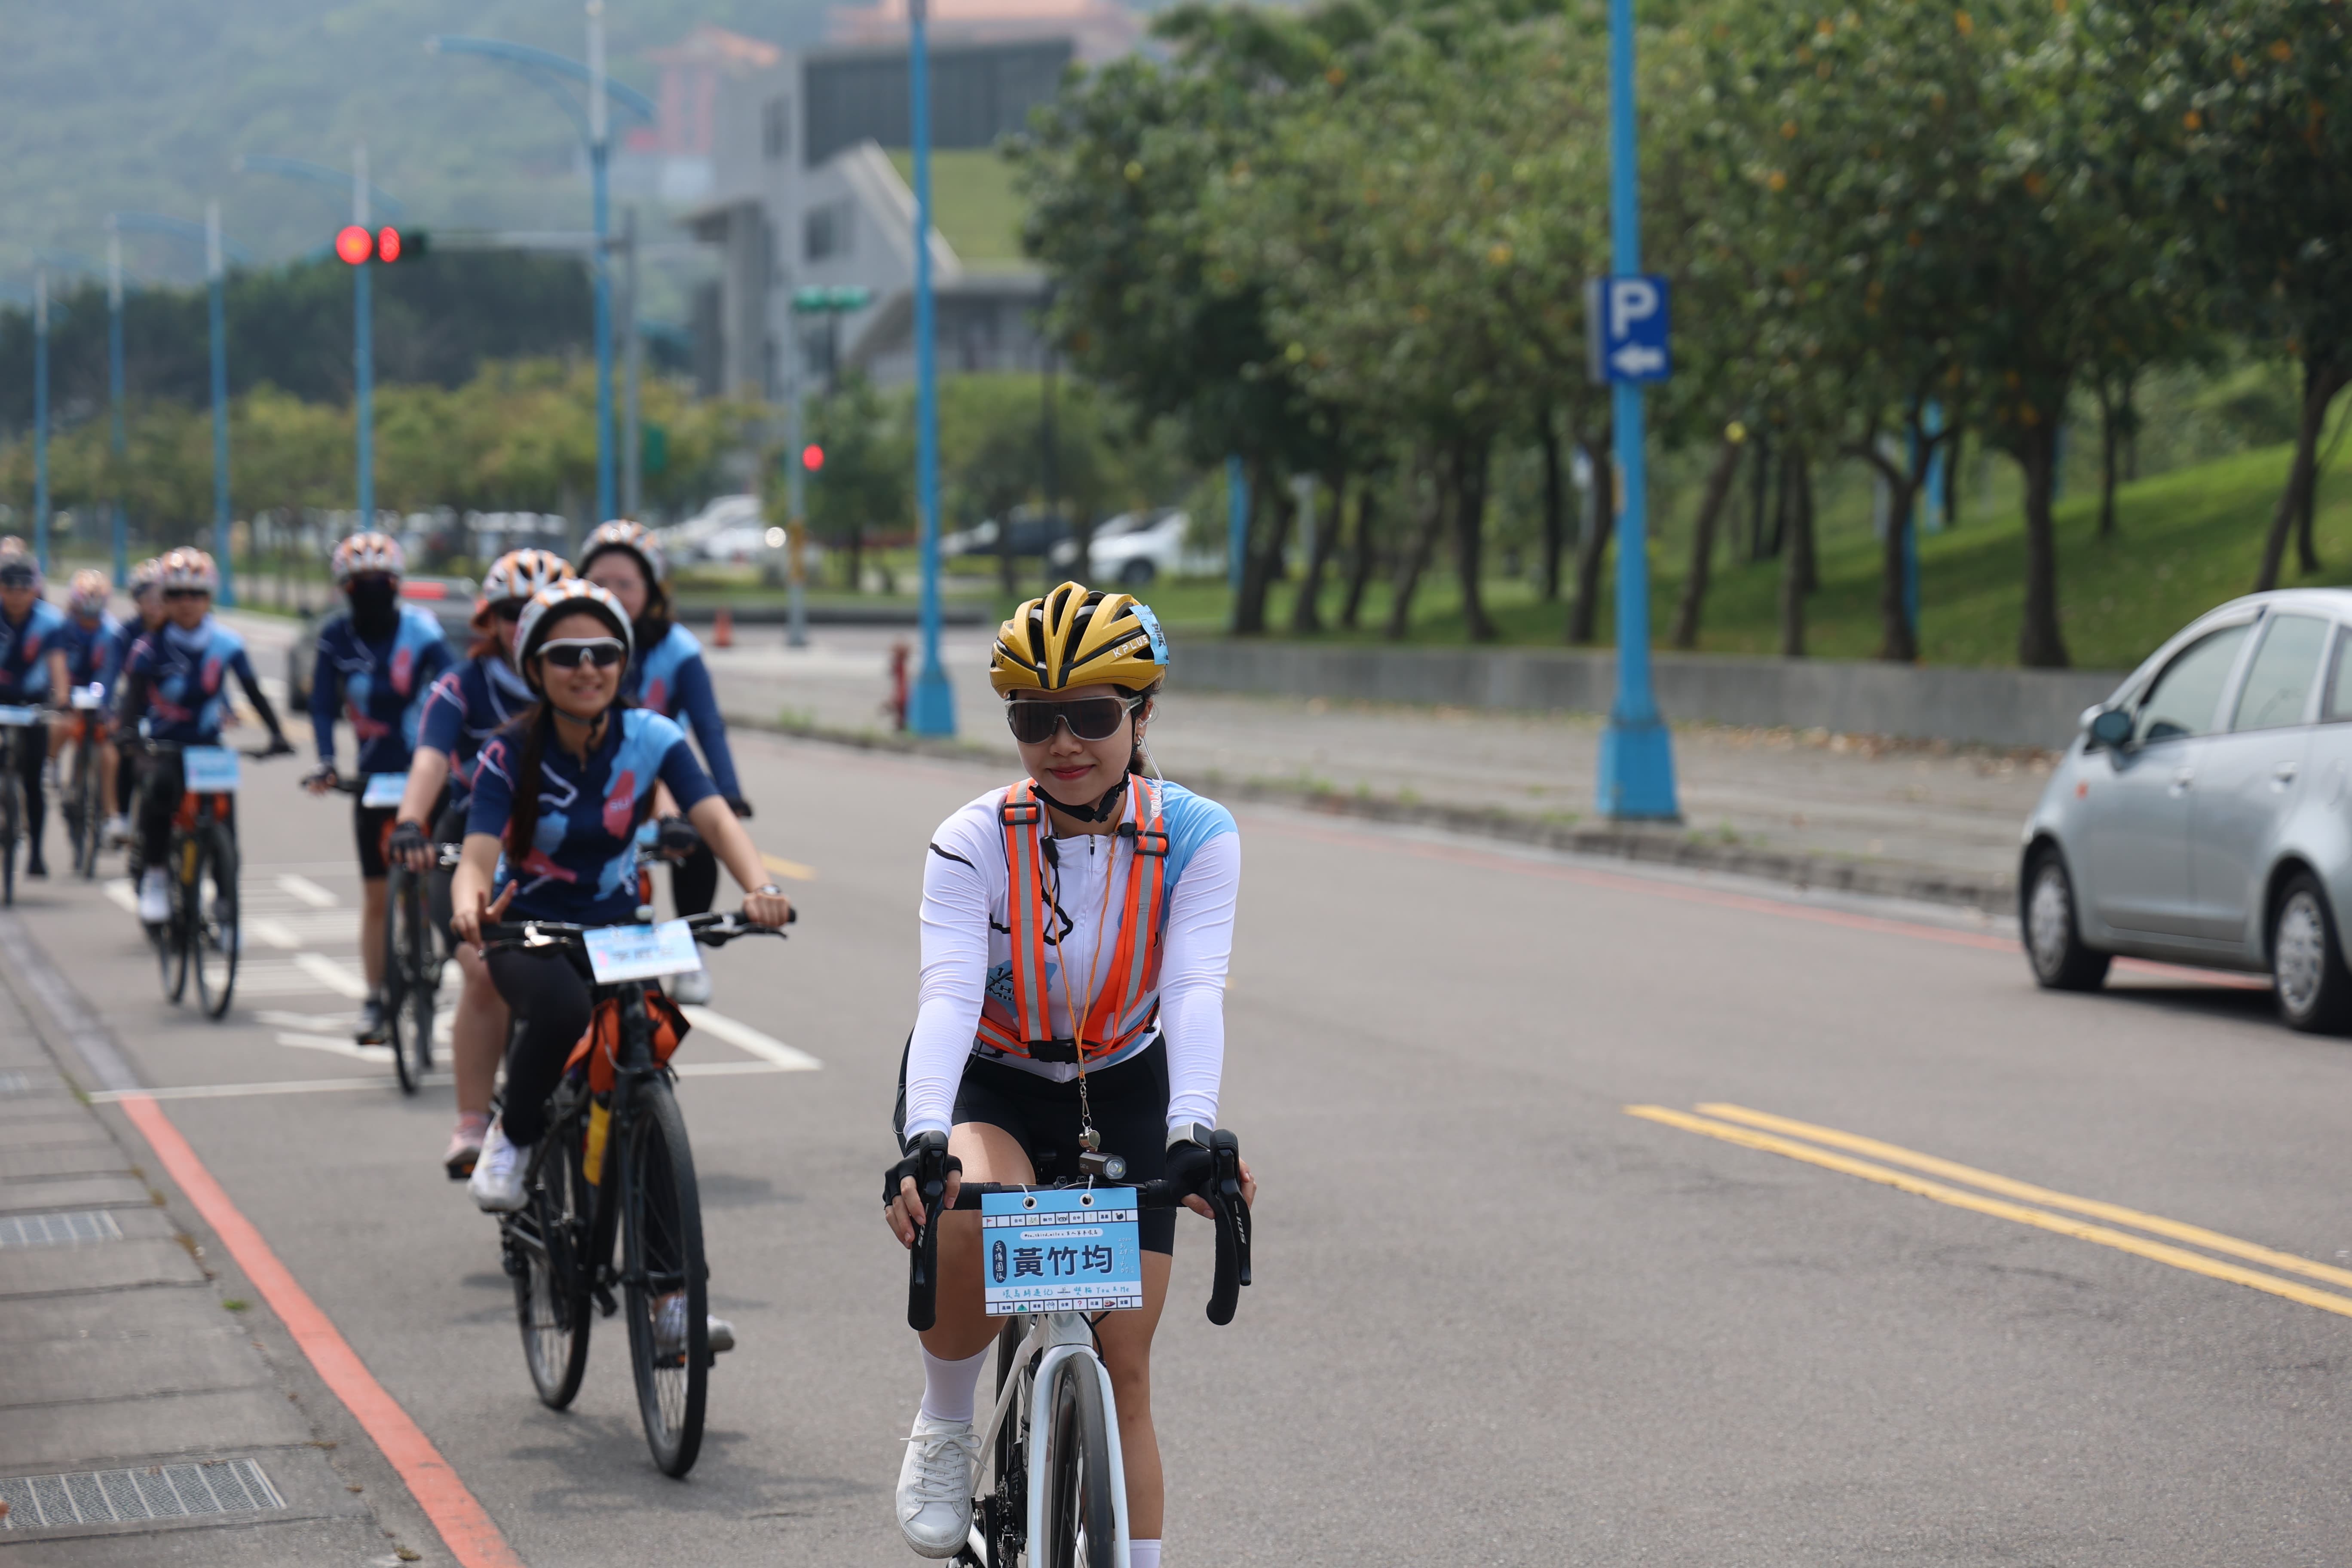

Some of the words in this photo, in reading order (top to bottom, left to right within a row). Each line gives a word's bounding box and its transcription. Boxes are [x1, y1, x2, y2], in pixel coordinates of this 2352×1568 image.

[1611, 280, 1658, 340] P
[1113, 636, 1150, 658] KPLUS
[1236, 1216, 1246, 1245] 105
[1013, 1244, 1113, 1278] 黃竹均
